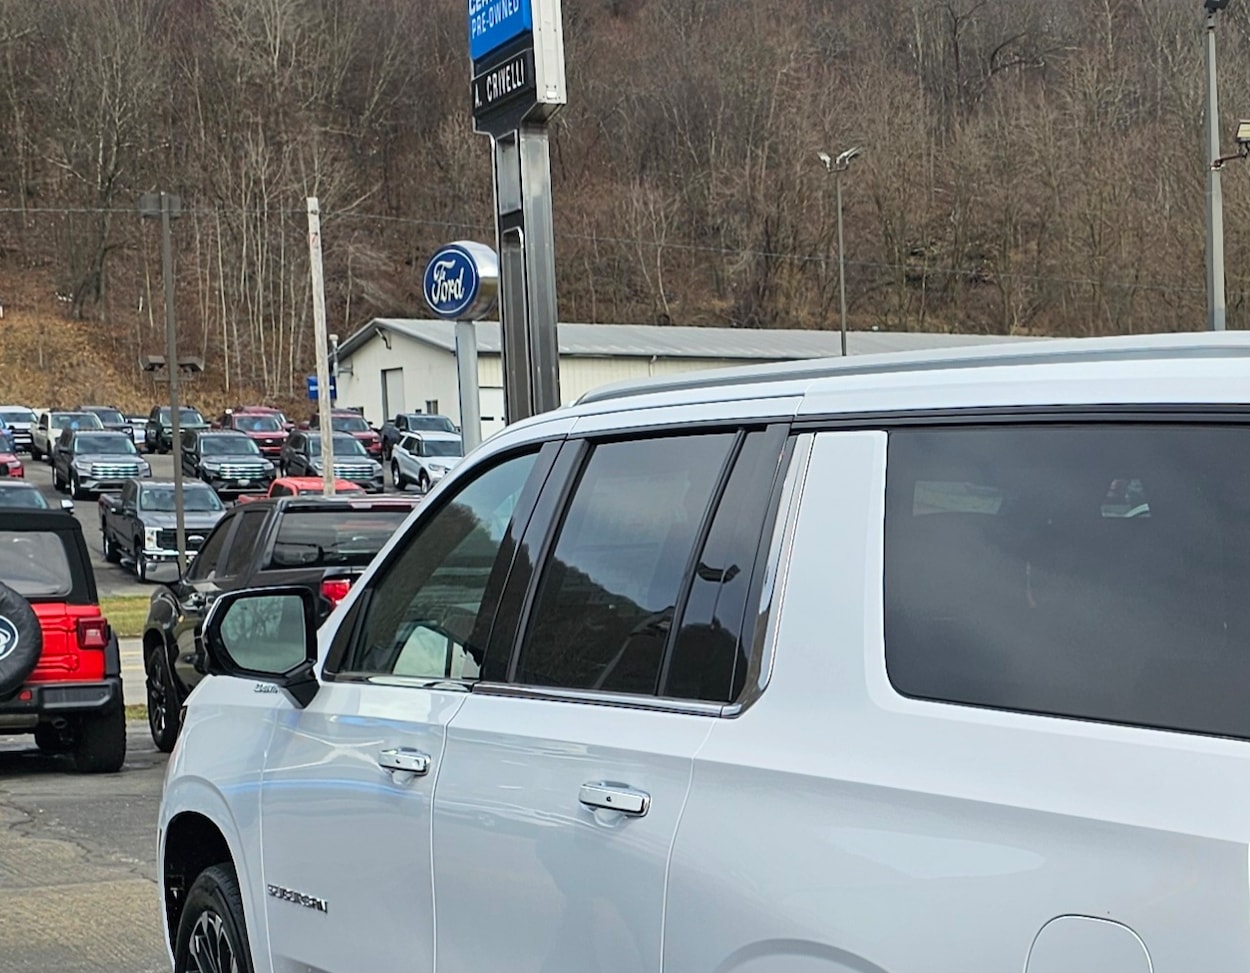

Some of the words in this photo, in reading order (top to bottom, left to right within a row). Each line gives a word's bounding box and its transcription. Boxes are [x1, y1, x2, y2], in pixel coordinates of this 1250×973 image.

[472, 0, 520, 39] PRE-OWNED
[475, 83, 482, 108] A.
[486, 58, 525, 102] CRIVELLI
[432, 260, 465, 304] Ford
